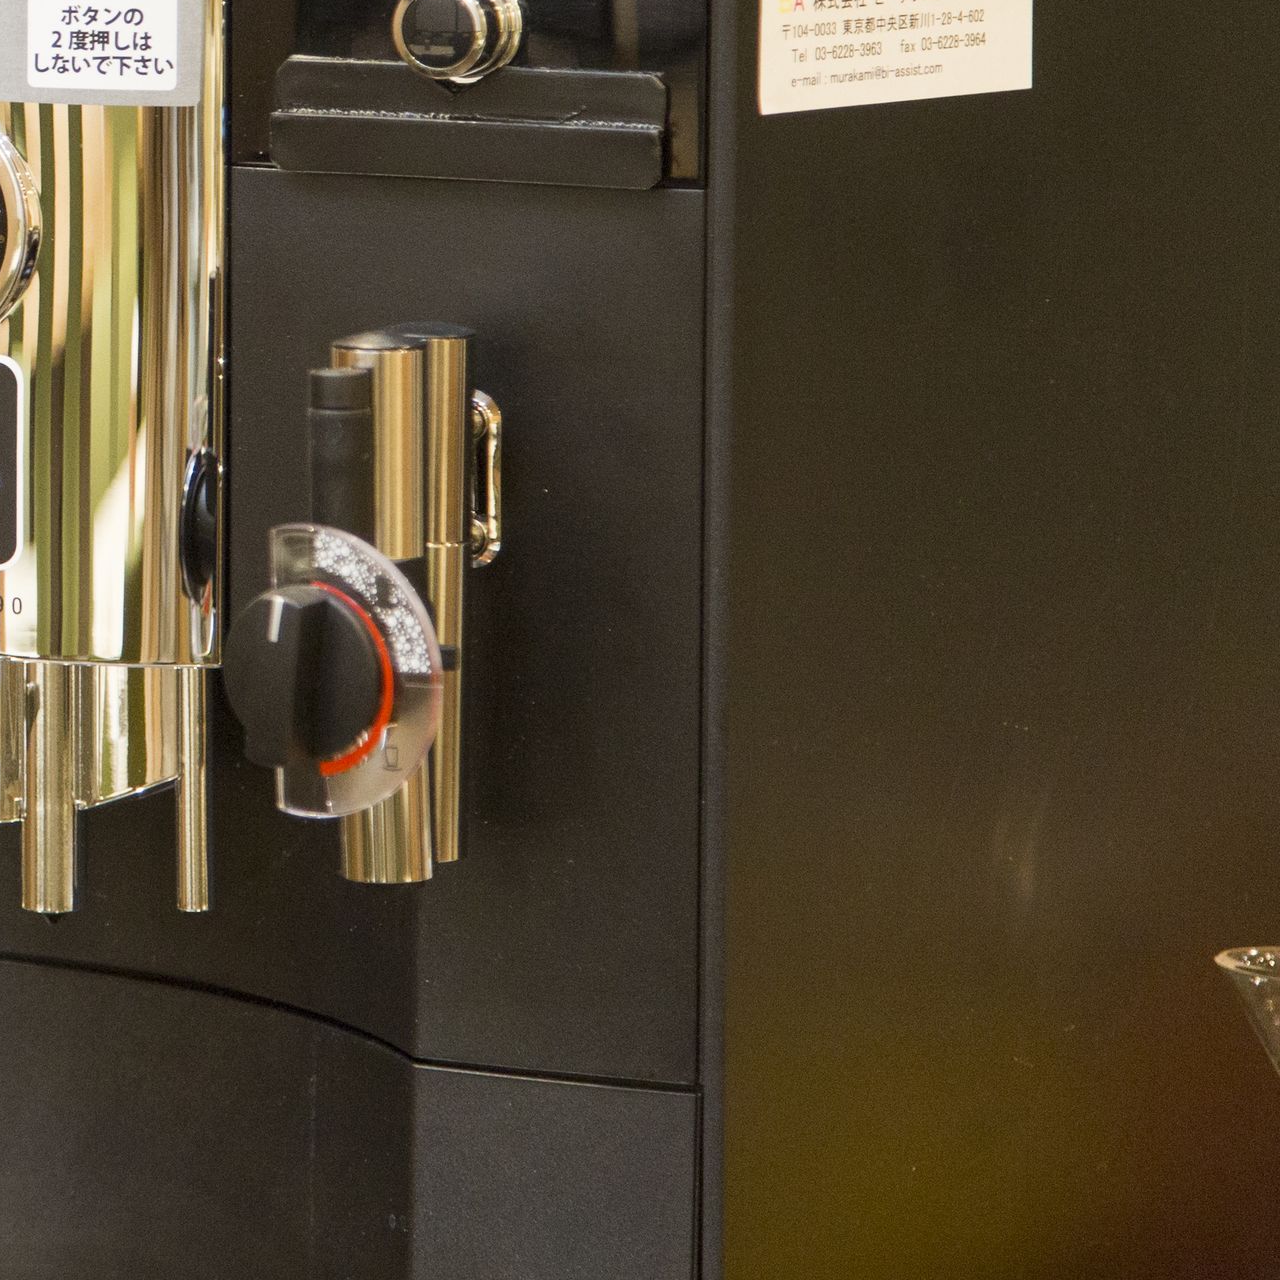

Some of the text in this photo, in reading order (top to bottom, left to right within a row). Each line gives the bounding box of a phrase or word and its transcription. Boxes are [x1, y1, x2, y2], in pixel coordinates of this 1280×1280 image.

[61, 6, 144, 26] ボタンの
[791, 48, 808, 63] Tel
[900, 38, 916, 54] fax
[34, 53, 174, 76] しないで下さい
